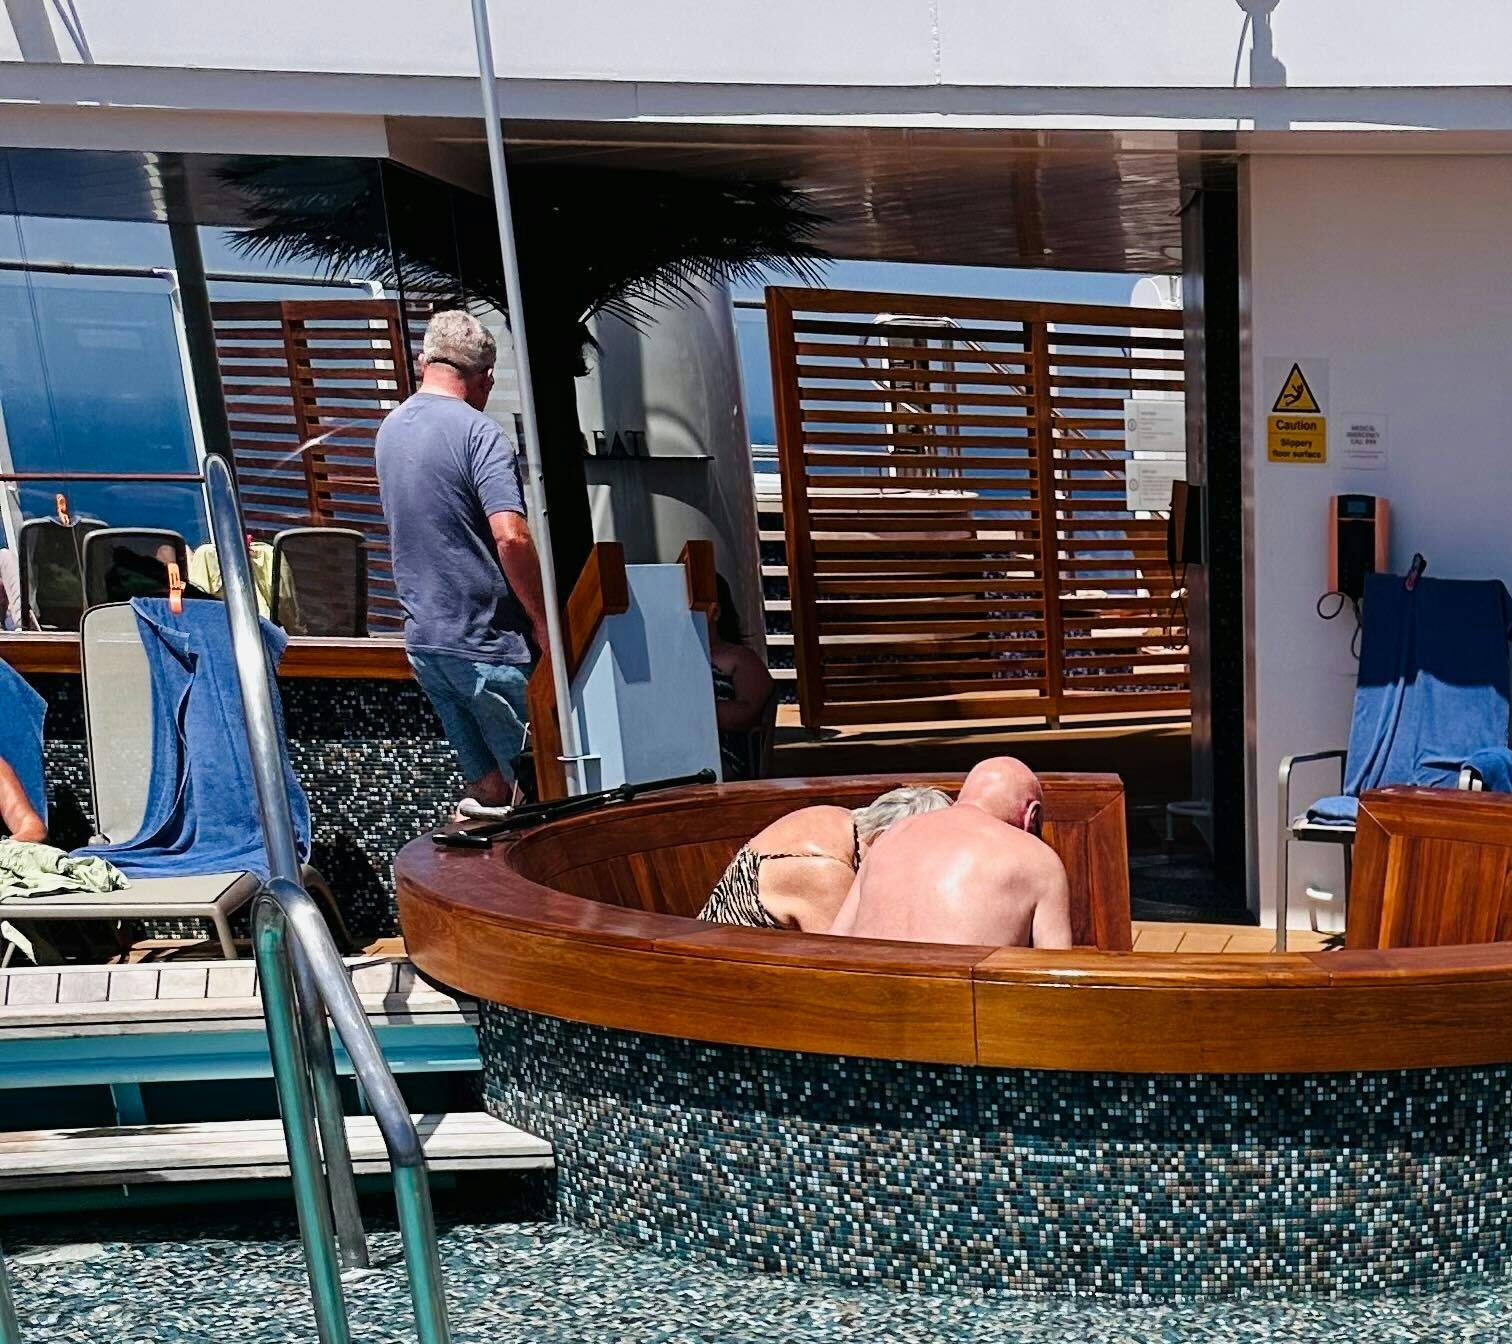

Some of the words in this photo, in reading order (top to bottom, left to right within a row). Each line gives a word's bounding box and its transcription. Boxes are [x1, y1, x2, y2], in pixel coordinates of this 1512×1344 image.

[1275, 420, 1317, 431] Caution
[1280, 438, 1313, 449] Slippery
[1271, 449, 1291, 457] floor
[1292, 450, 1321, 459] surface
